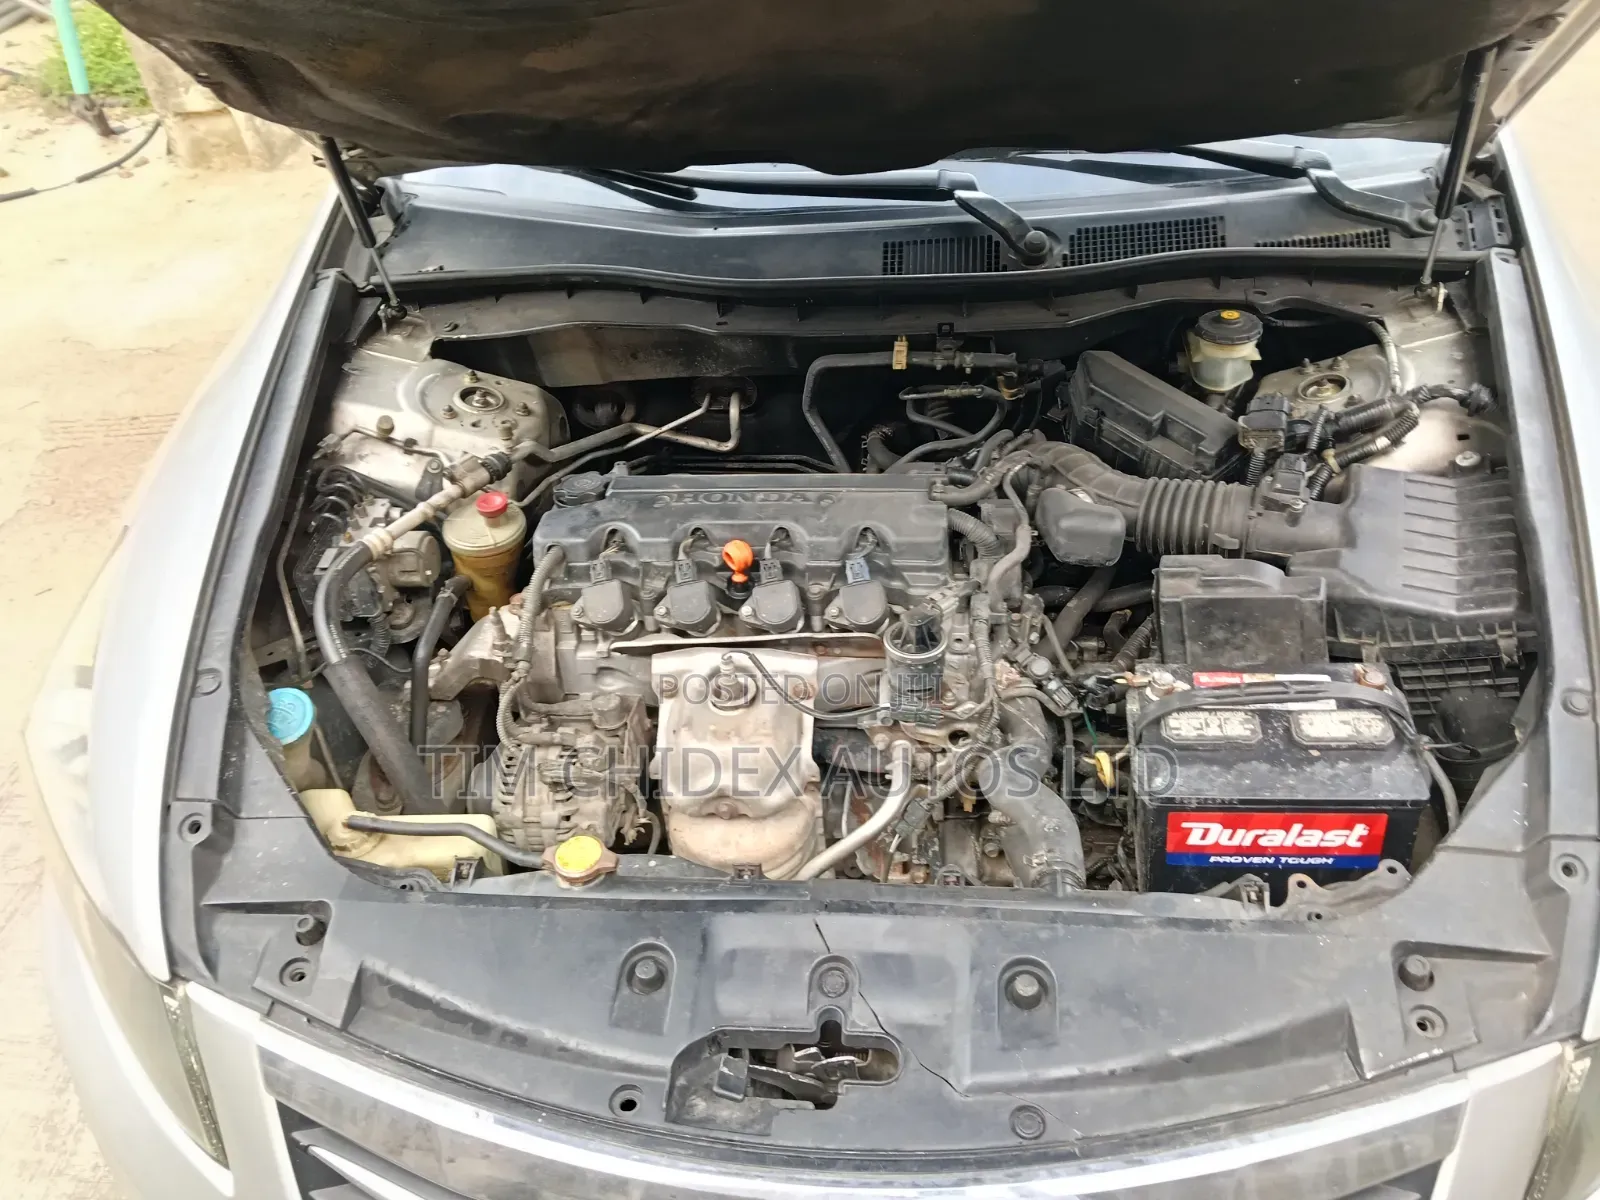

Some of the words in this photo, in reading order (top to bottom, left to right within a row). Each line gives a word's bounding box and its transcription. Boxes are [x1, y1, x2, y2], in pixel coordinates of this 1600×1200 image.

[671, 492, 815, 505] HONDA
[1181, 822, 1370, 848] Duralast
[1209, 855, 1276, 864] PROVEN
[1279, 856, 1335, 865] TOUGH
